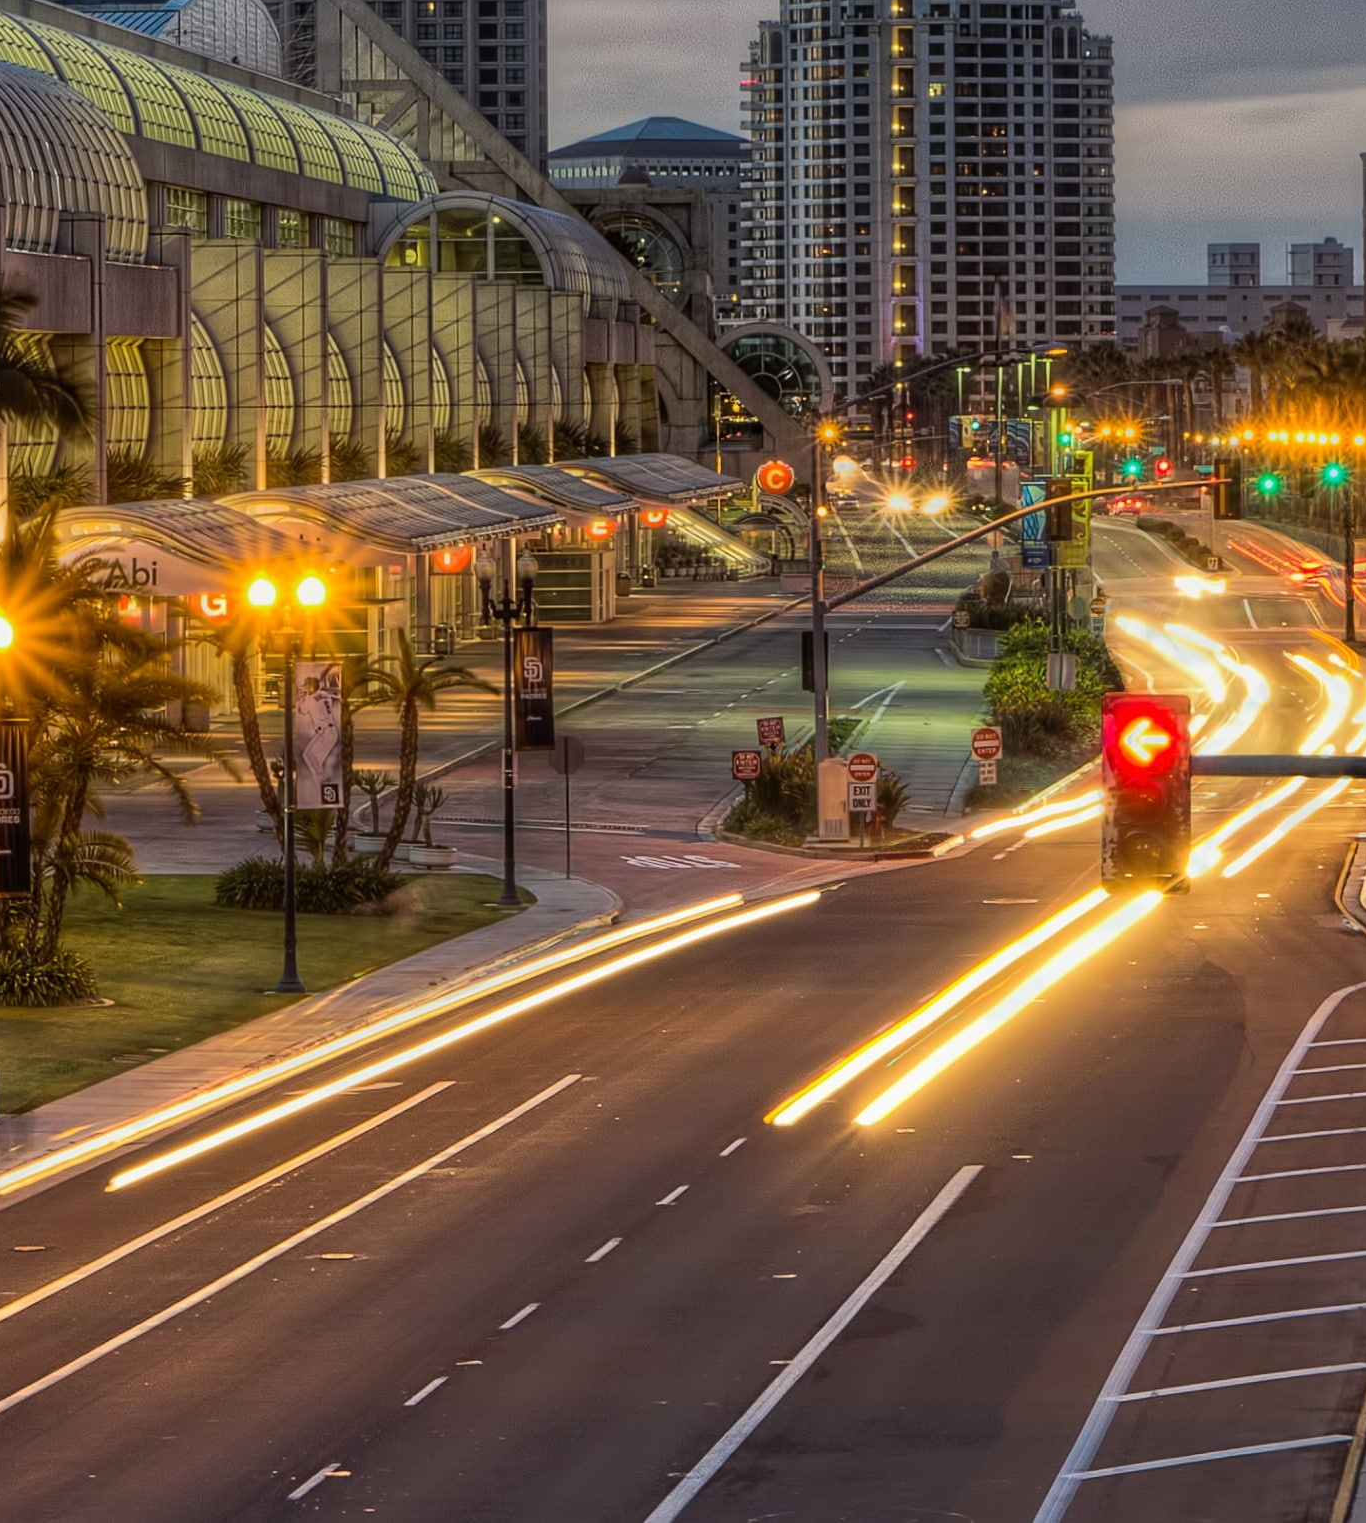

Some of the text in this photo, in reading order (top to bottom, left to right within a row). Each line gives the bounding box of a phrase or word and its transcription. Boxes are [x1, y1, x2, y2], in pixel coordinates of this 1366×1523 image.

[767, 469, 784, 489] C
[523, 656, 543, 682] SD
[853, 786, 871, 795] EXIT
[853, 798, 871, 808] ONLY
